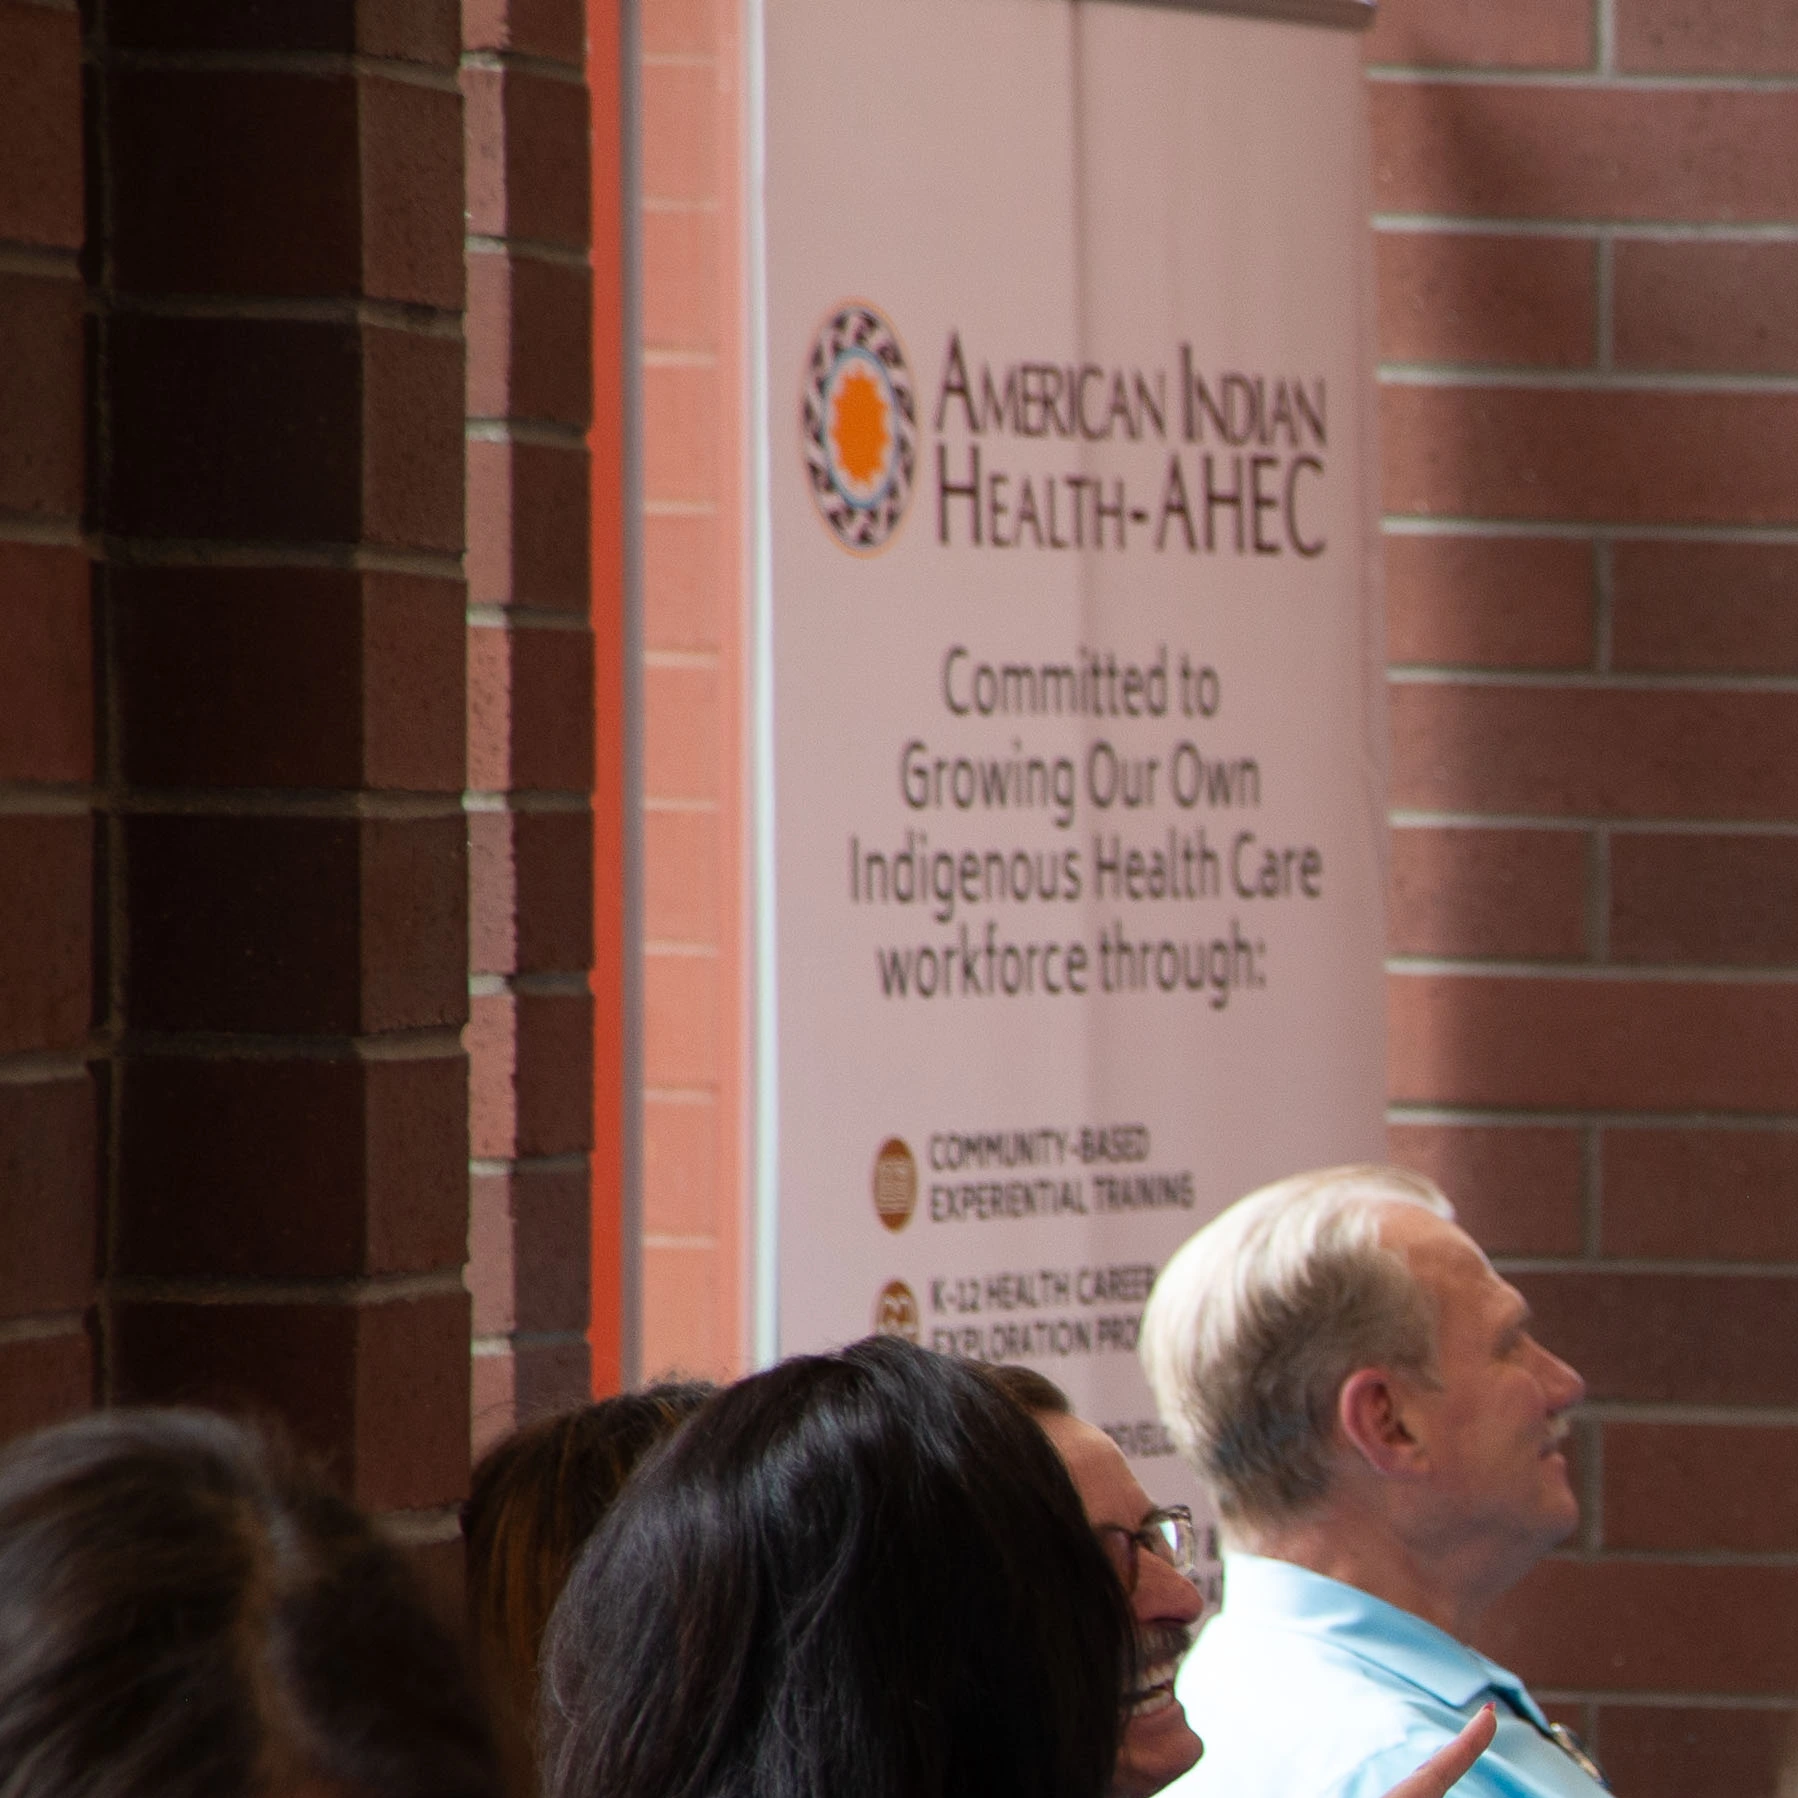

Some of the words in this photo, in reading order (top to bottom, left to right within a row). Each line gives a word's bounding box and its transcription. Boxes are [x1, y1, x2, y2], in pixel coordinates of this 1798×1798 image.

[942, 643, 1170, 718] Committed
[1180, 652, 1222, 718] to
[901, 736, 1076, 829] Growing
[1087, 739, 1161, 810] Our
[1172, 739, 1261, 810] Own
[849, 829, 1084, 924] Indigenous
[1094, 825, 1221, 901] Health
[1230, 829, 1323, 901] Care
[876, 918, 1090, 1001] workforce
[1100, 916, 1267, 1010] through:
[929, 1178, 1088, 1222] EXPERIENTIAL
[1093, 1170, 1195, 1214] TRAINING
[930, 1276, 980, 1314] K-12
[984, 1268, 1072, 1310] HEALTH
[930, 1319, 1092, 1364] EXPLORATION
